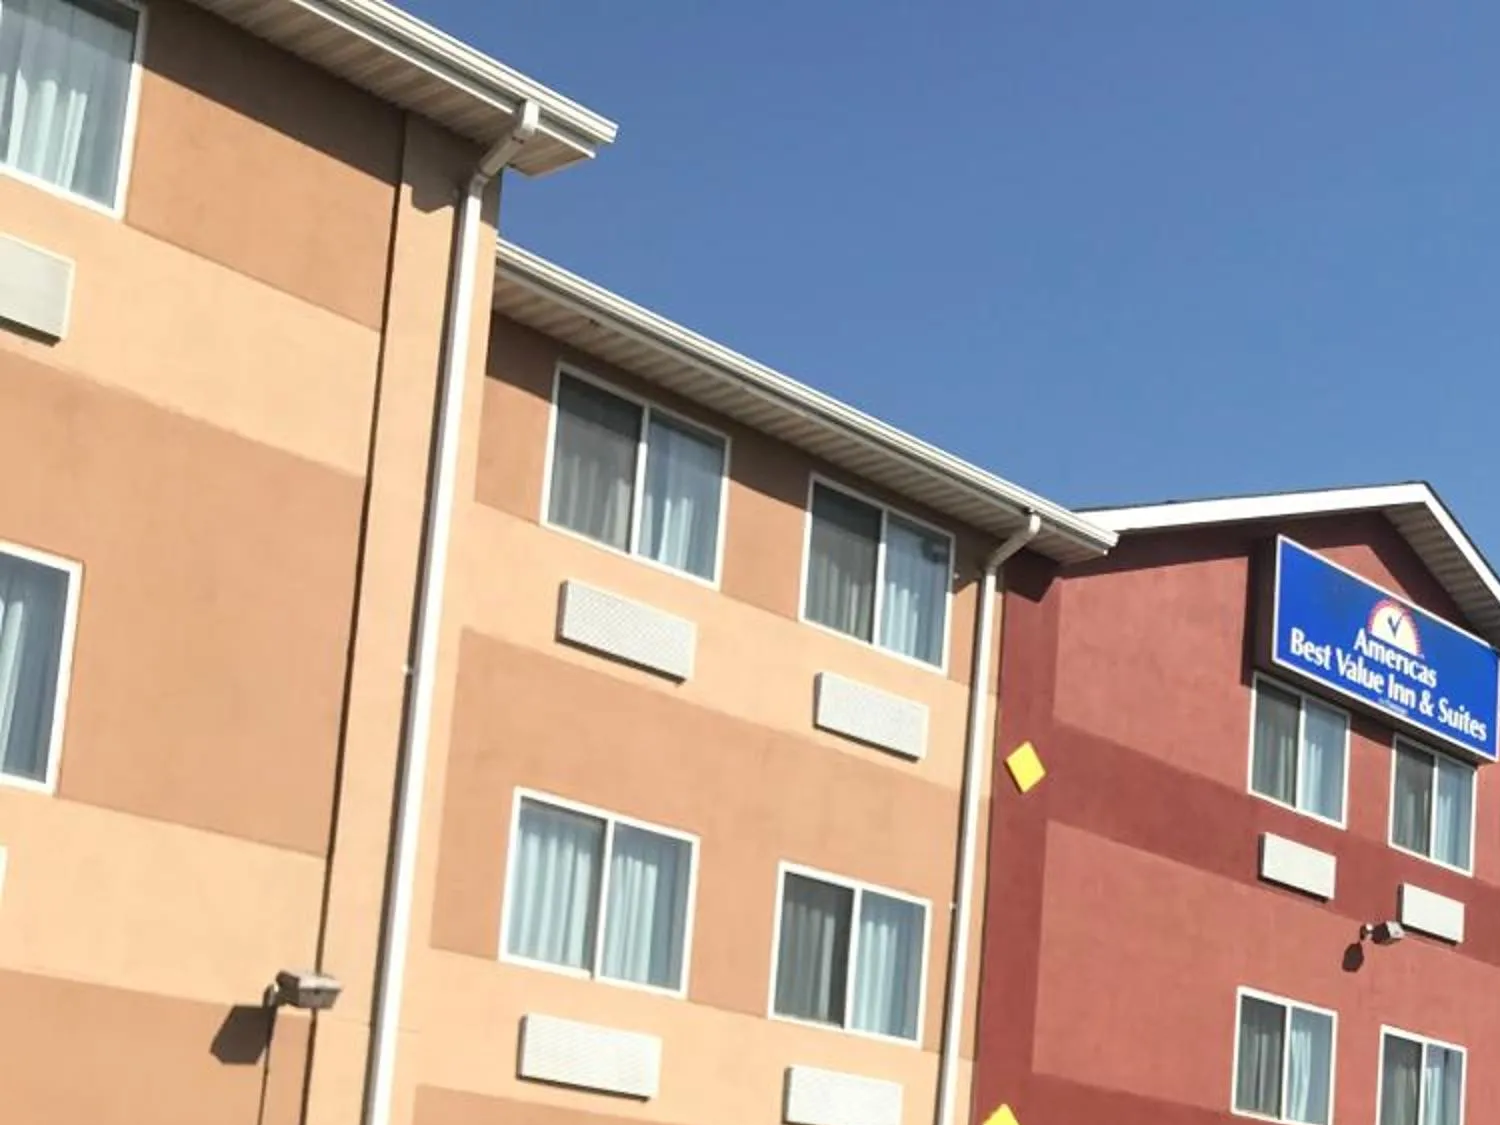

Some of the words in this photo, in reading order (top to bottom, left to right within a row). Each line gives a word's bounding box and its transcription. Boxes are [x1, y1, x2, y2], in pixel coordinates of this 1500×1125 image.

[1290, 627, 1331, 671] Best
[1335, 647, 1384, 693] Value
[1387, 674, 1416, 710] Inn
[1418, 690, 1435, 718] &
[1437, 697, 1487, 742] Suites
[1353, 628, 1437, 689] Americas
